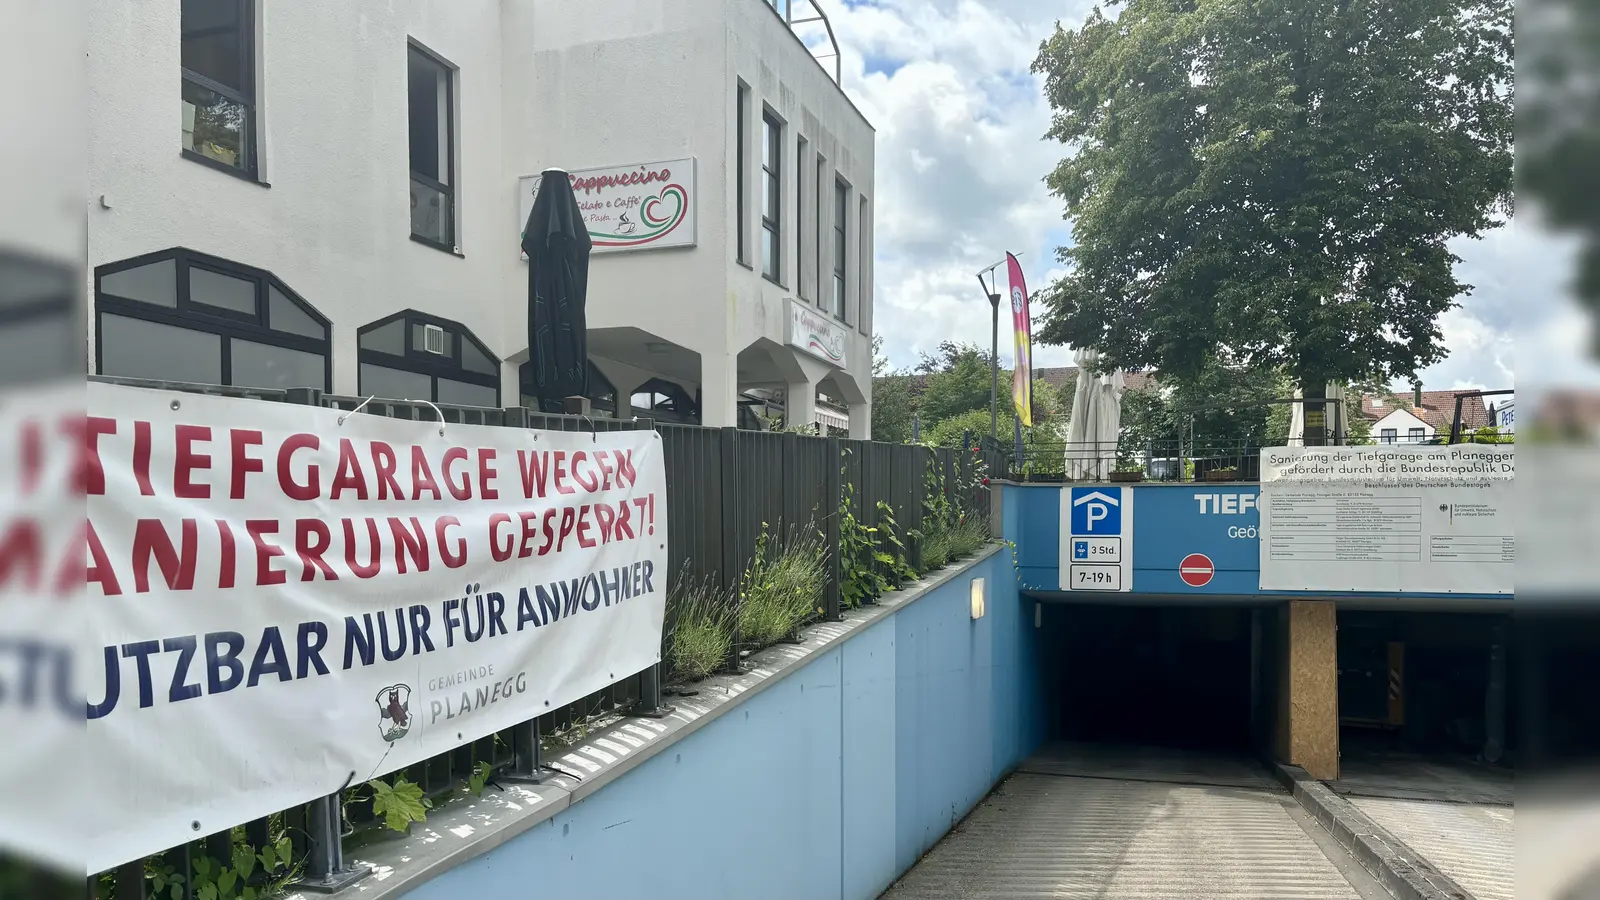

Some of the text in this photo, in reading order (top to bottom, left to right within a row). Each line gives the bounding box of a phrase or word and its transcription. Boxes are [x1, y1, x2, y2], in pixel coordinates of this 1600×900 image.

[590, 214, 611, 222] Pasta
[1270, 453, 1328, 464] Sanierung
[1333, 452, 1352, 462] der
[1356, 450, 1423, 463] Tiefgarage
[1451, 450, 1514, 464] Planegger
[1280, 464, 1334, 476] gefördert
[1338, 463, 1373, 474] durch
[1377, 462, 1396, 473] die
[1401, 462, 1497, 475] Bundesrepublik
[517, 449, 637, 498] WEGEN
[1194, 493, 1260, 514] TIEF
[488, 493, 655, 562] GESPERRT!
[1087, 503, 1108, 531] P
[1091, 546, 1117, 554] 3 Std.
[1106, 572, 1112, 583] h
[342, 604, 435, 670] NUR
[443, 583, 508, 648] FÜR
[516, 559, 654, 632] ANWOHNER
[428, 664, 495, 692] GEMEINDE
[431, 671, 527, 725] PLANEGG
